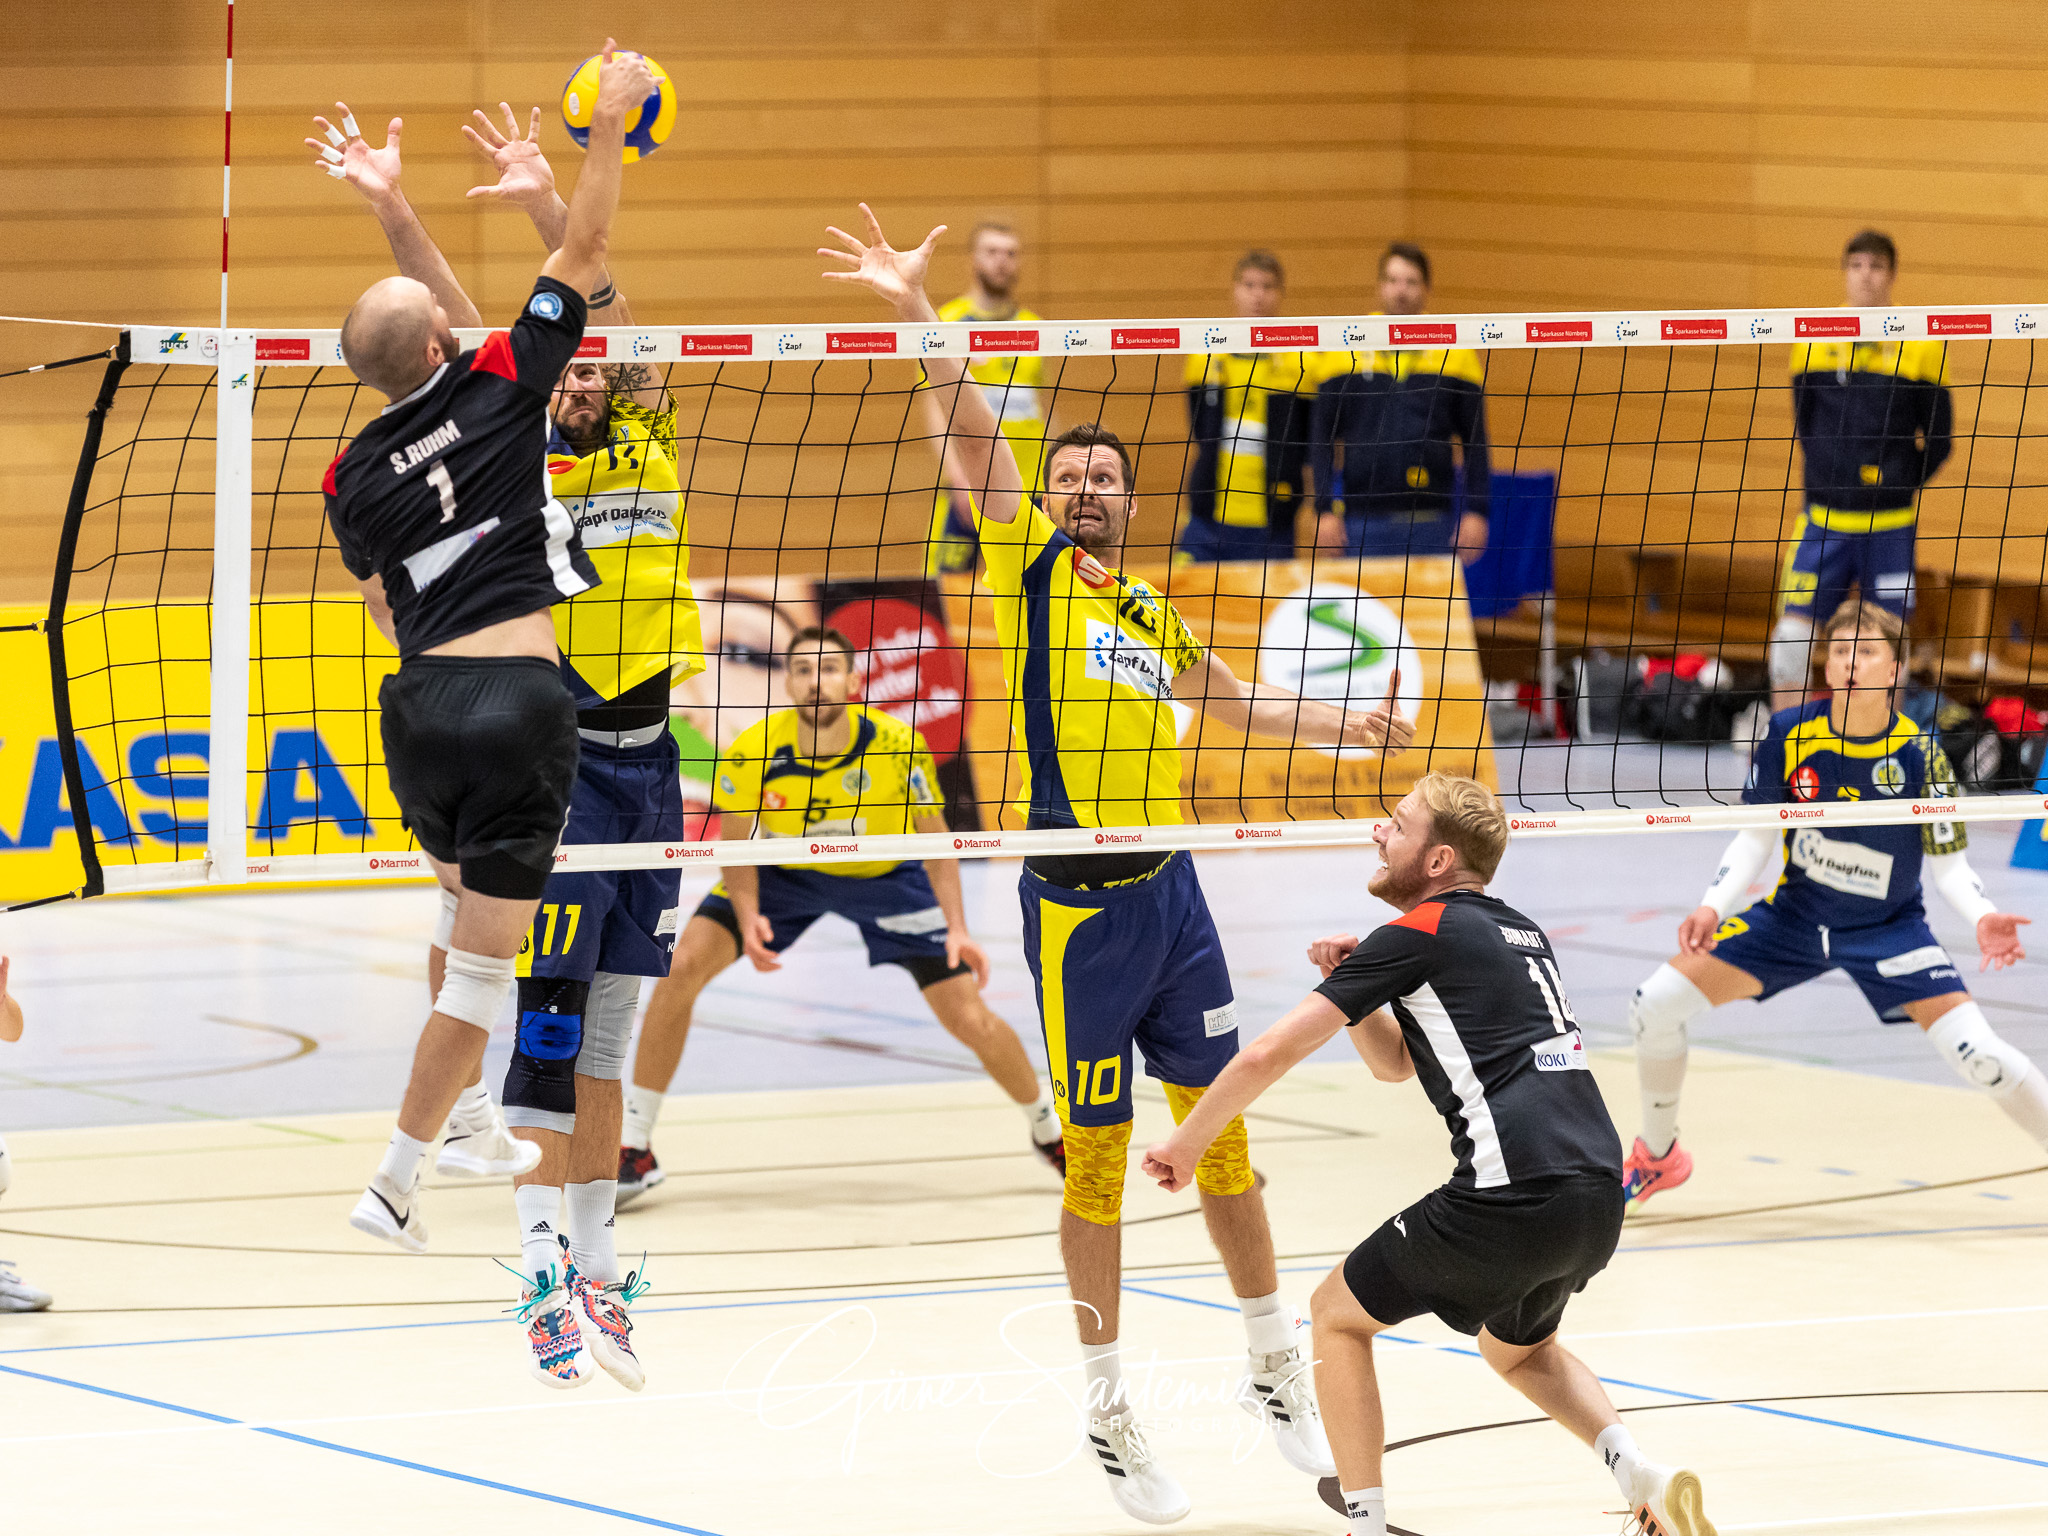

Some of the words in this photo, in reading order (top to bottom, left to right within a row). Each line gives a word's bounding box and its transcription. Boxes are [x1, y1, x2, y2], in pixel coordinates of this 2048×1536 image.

[1757, 326, 1772, 335] Zapf
[1808, 325, 1832, 334] Sparkasse
[1833, 324, 1856, 334] Nürnberg
[1889, 324, 1905, 333] Zapf
[1940, 322, 1964, 331] Sparkasse
[1965, 321, 1988, 331] Nürnberg
[2021, 321, 2037, 330] Zapf
[1403, 332, 1426, 341] Sparkasse
[1427, 330, 1452, 340] Nürnberg
[1487, 331, 1503, 340] Zapf
[1540, 329, 1563, 338] Sparkasse
[1564, 328, 1588, 338] Nürnberg
[1622, 328, 1638, 337] Zapf
[1675, 327, 1698, 336] Sparkasse
[1699, 326, 1723, 336] Nürnberg
[984, 338, 1009, 347] Sparkasse
[1010, 337, 1034, 347] Nürnberg
[1071, 337, 1088, 347] Zapf
[1125, 336, 1150, 346] Sparkasse
[1151, 335, 1175, 345] Nürnberg
[1211, 335, 1227, 344] Zapf
[1265, 335, 1289, 344] Sparkasse
[1290, 333, 1314, 343] Nürnberg
[1349, 333, 1365, 342] Zapf
[160, 341, 188, 350] HUCK
[640, 344, 657, 353] Zapf
[696, 342, 722, 351] Sparkasse
[723, 341, 748, 351] Nürnberg
[785, 342, 802, 351] Zapf
[841, 340, 866, 349] Sparkasse
[867, 338, 892, 349] Nürnberg
[928, 340, 945, 349] Zapf
[389, 419, 462, 475] S.RUHM
[425, 459, 458, 524] 1
[0, 728, 375, 850] ASA
[1789, 809, 1825, 818] Marmot
[1922, 804, 1957, 814] Marmot
[1521, 819, 1557, 829] Marmot
[1656, 814, 1691, 824] Marmot
[1245, 828, 1282, 838] Marmot
[963, 838, 1001, 848] Marmot
[1105, 833, 1142, 844] Marmot
[676, 847, 714, 857] Marmot
[821, 843, 859, 853] Marmot
[380, 858, 419, 868] Marmot
[247, 864, 270, 874] rmot
[541, 904, 582, 956] 11
[1075, 1055, 1121, 1106] 10
